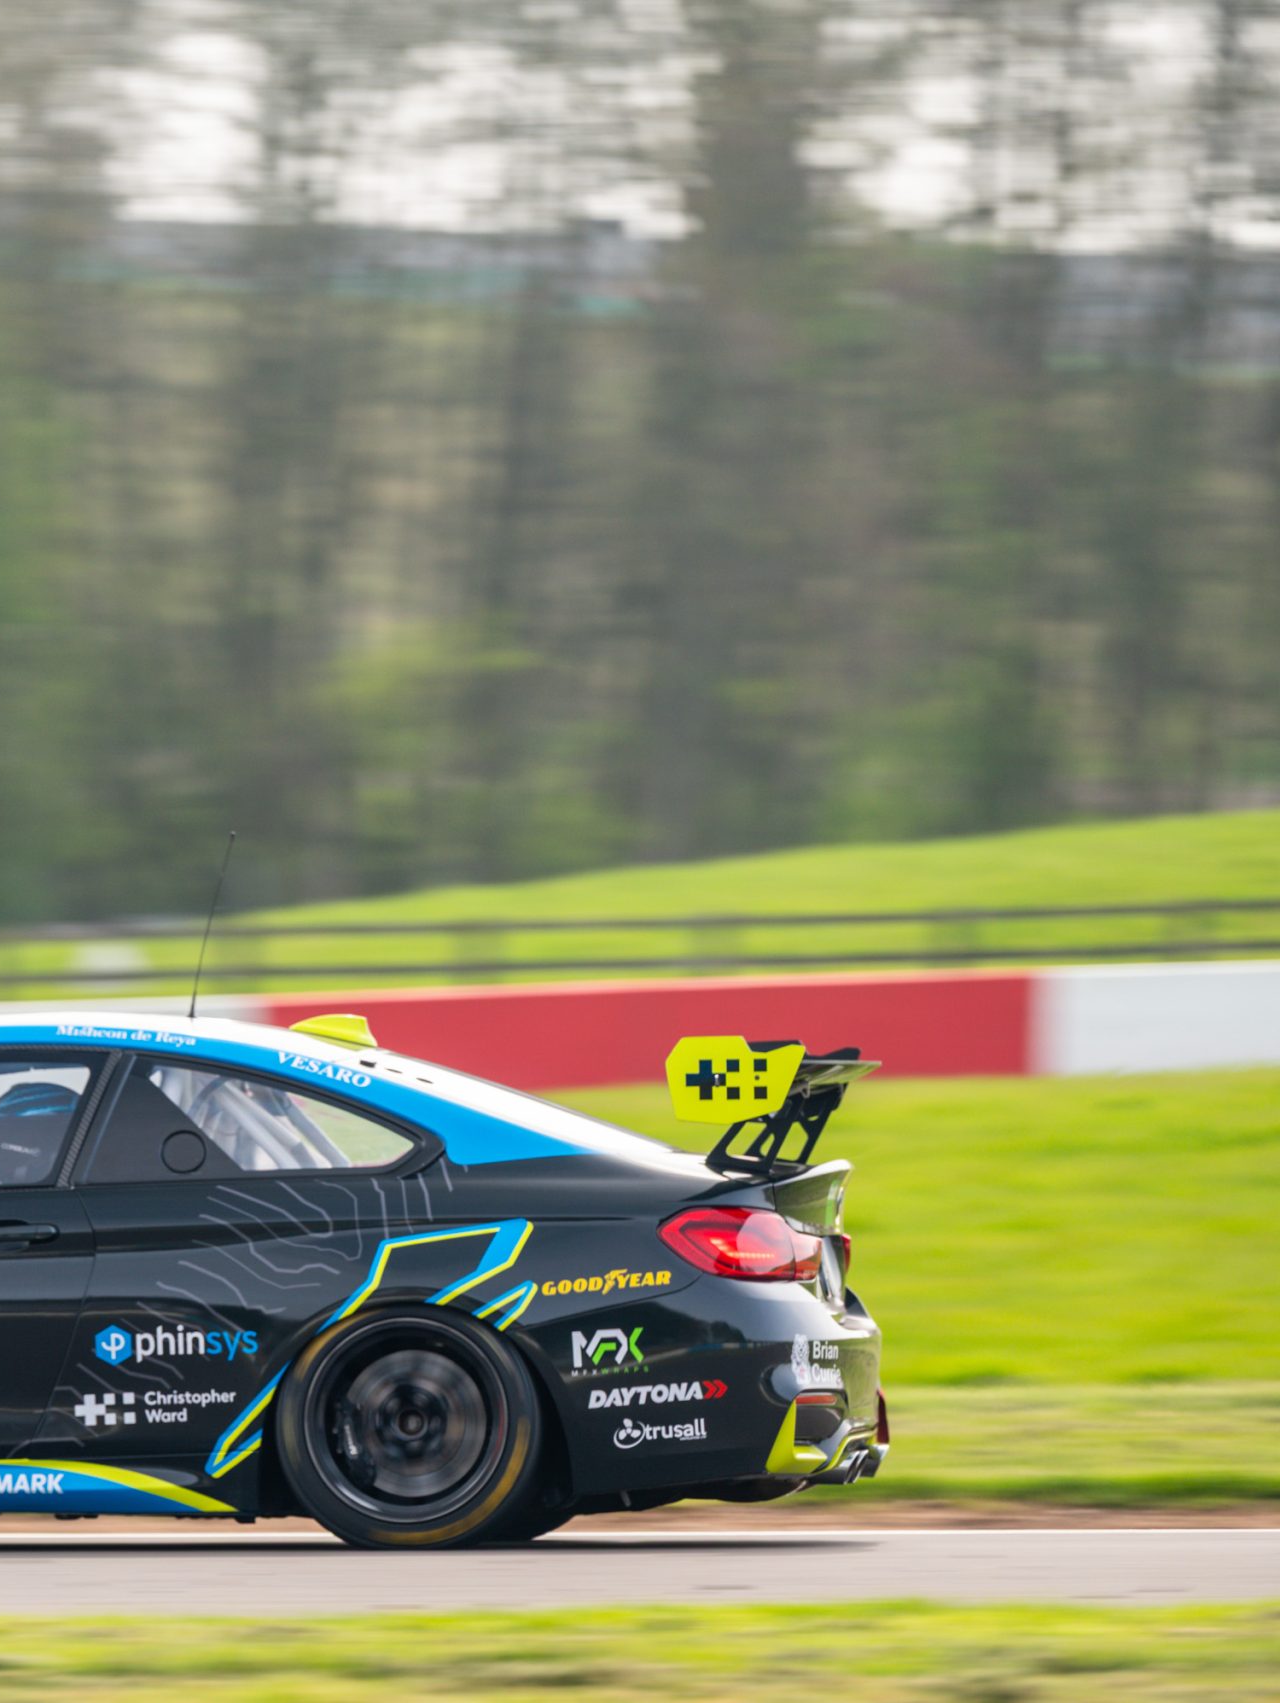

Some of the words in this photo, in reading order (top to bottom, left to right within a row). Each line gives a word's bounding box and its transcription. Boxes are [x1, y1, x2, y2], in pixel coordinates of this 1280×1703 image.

[131, 1030, 152, 1041] de
[155, 1031, 197, 1047] Reya
[278, 1051, 372, 1088] VESARO
[541, 1268, 672, 1296] GOODYEAR
[135, 1324, 258, 1363] phinsys
[812, 1340, 839, 1360] Brian
[144, 1389, 236, 1408] Christopher
[588, 1381, 704, 1409] DAYTONA
[144, 1408, 188, 1424] Ward
[645, 1417, 708, 1440] trusall
